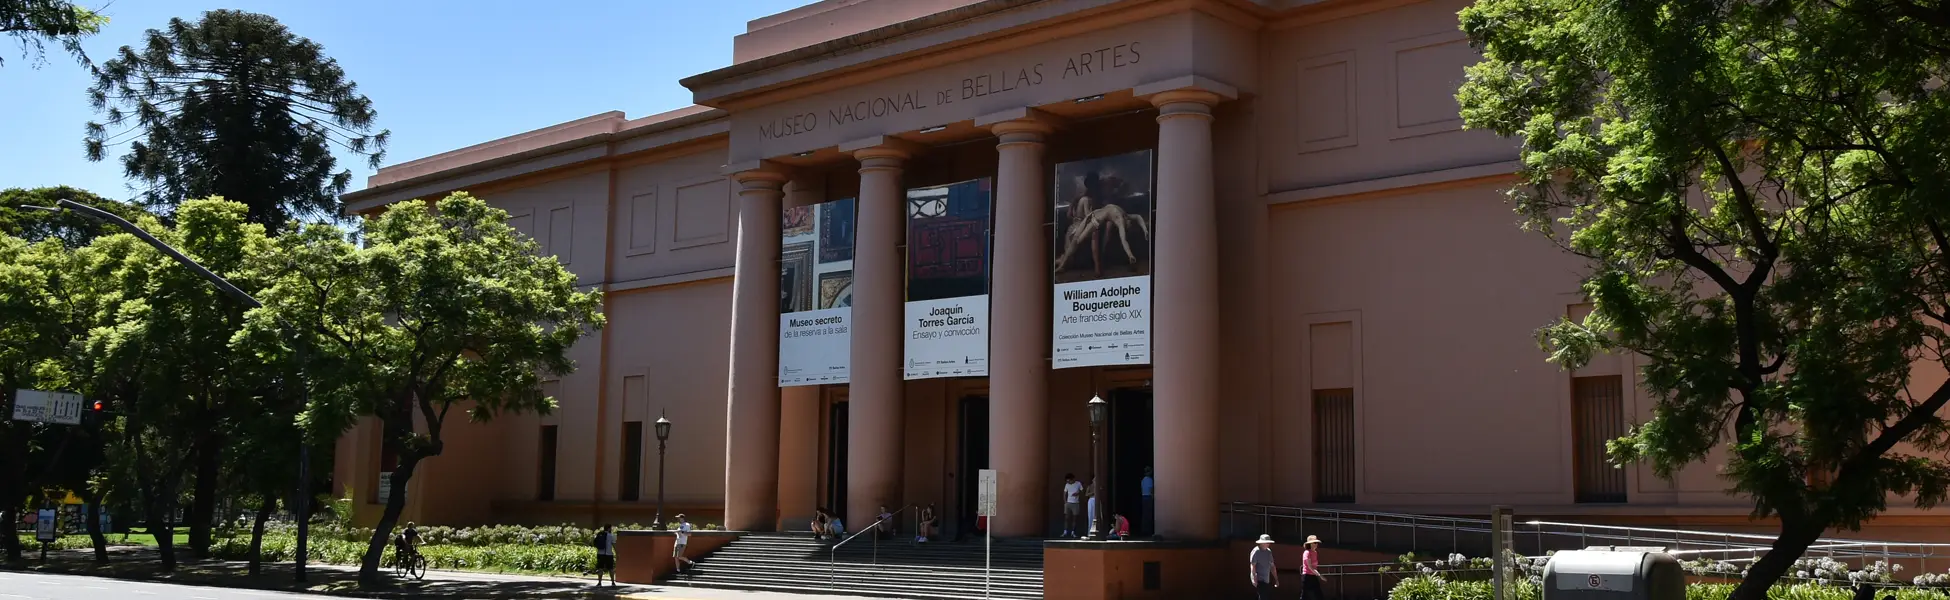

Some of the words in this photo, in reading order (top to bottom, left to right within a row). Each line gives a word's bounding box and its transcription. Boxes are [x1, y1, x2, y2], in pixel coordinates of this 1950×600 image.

[758, 112, 817, 142] MUSEO
[827, 89, 927, 130] NACIONAL
[936, 88, 953, 106] DE
[961, 63, 1043, 100] BELLAS
[1062, 41, 1141, 80] ARTES
[1063, 289, 1098, 301] William
[1100, 285, 1141, 298] Adolphe
[929, 304, 963, 317] Joaquín
[1072, 299, 1131, 312] Bouguereau
[789, 318, 814, 328] Museo
[815, 316, 843, 326] secreto
[918, 318, 945, 328] Torres
[946, 314, 974, 326] García
[1062, 315, 1078, 324] Arte
[1079, 312, 1107, 323] francés
[1109, 309, 1127, 322] siglo
[1128, 309, 1142, 319] XIX
[784, 330, 792, 339] de
[793, 329, 799, 337] la
[799, 328, 822, 337] reserva
[822, 328, 827, 336] a
[827, 326, 834, 335] la
[834, 325, 848, 334] sala
[912, 330, 937, 340] Ensayo
[938, 330, 943, 339] y
[943, 326, 980, 337] convicción
